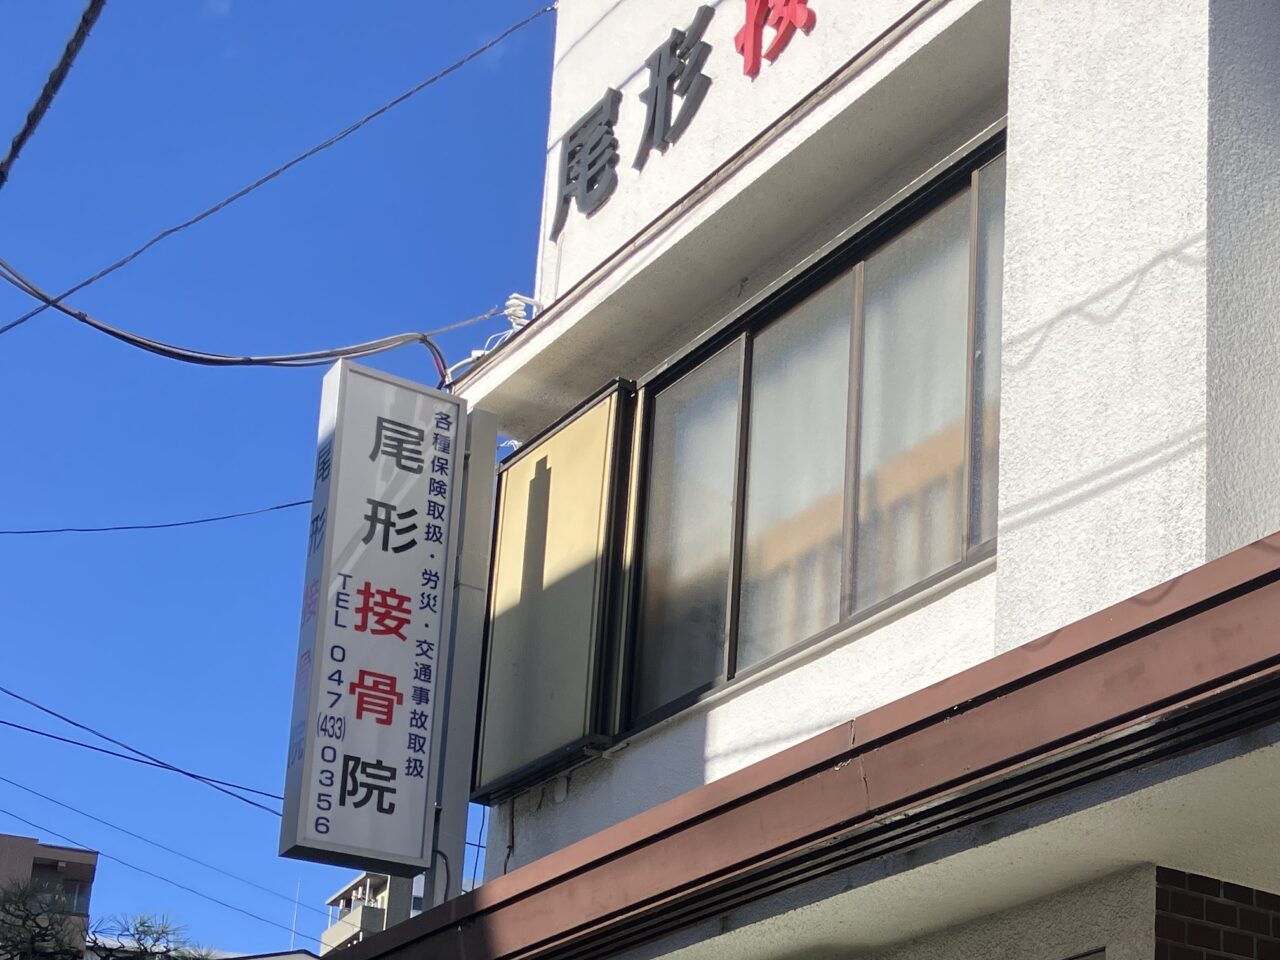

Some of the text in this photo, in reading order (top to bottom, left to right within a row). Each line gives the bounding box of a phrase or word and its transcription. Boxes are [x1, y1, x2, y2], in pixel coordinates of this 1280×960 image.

[333, 573, 353, 629] TEL
[338, 416, 426, 816] 尾形接骨院
[404, 410, 453, 780] 各種保険取扱・労災・交通事故取扱
